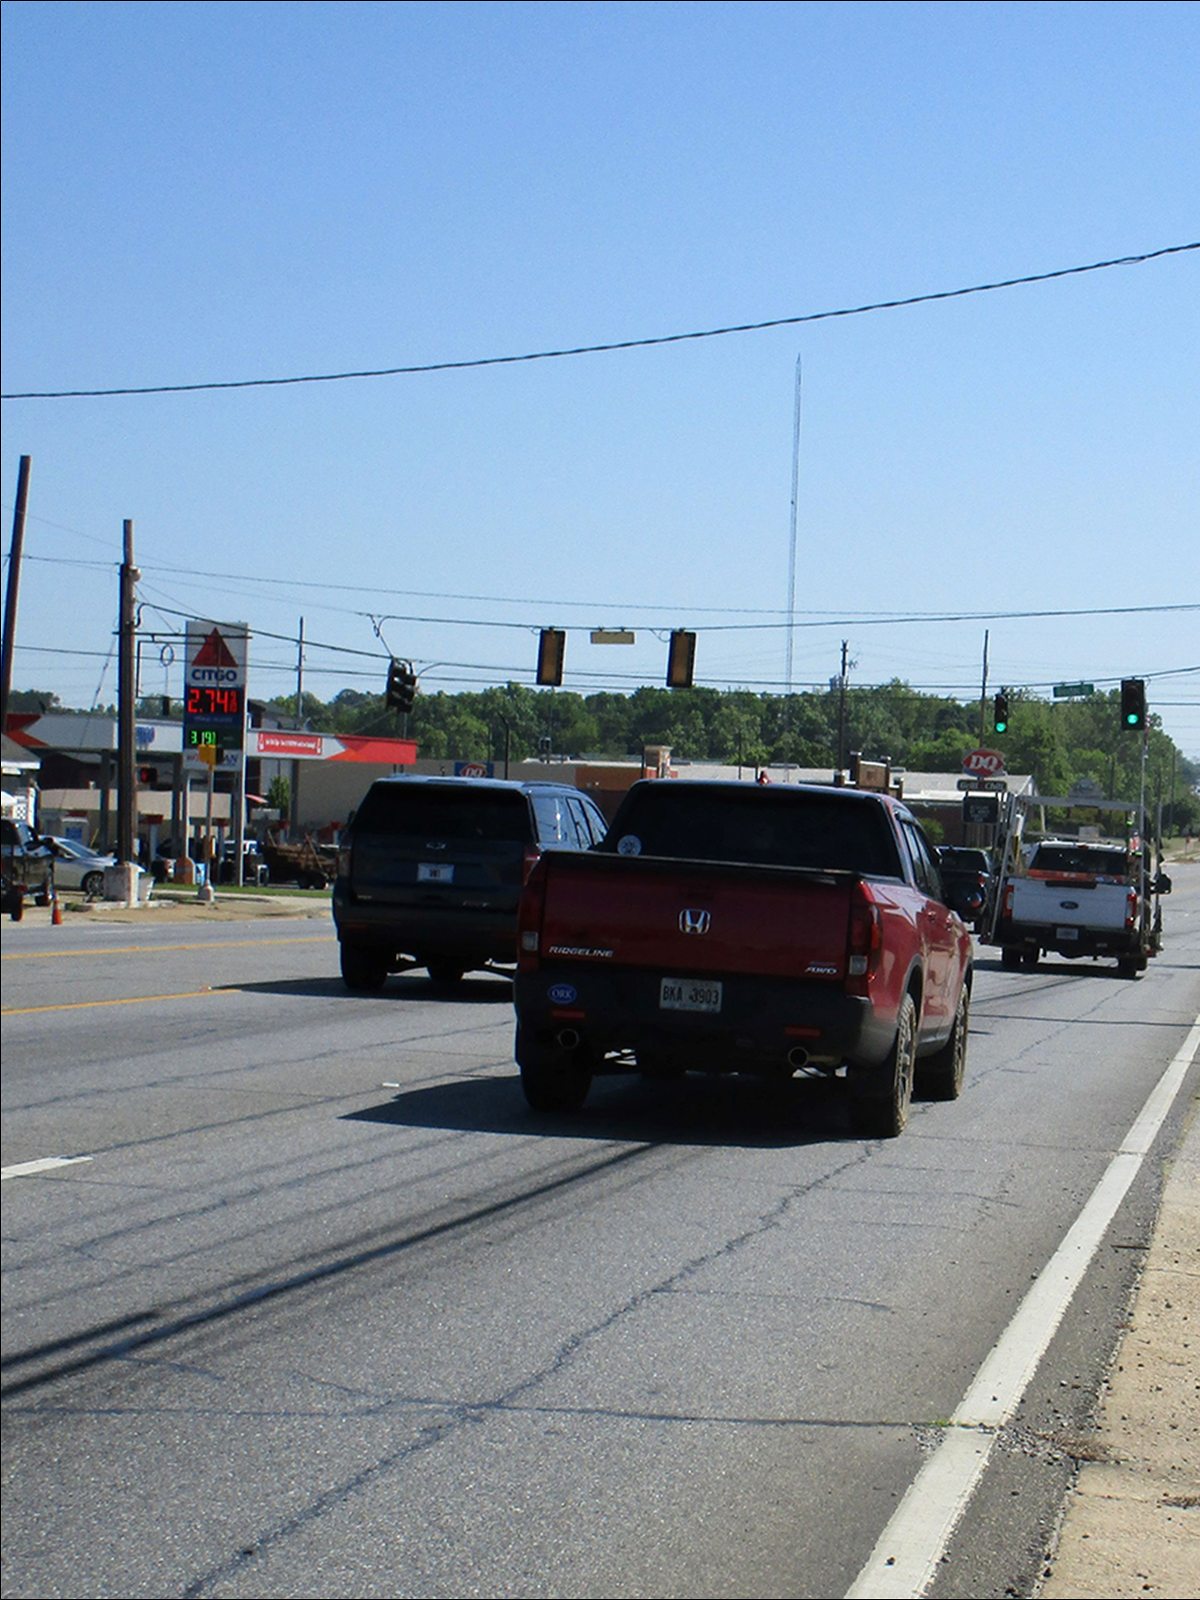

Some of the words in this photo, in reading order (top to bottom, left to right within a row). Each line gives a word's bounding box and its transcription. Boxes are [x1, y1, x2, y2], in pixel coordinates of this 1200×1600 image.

[191, 668, 237, 682] CITGO
[969, 755, 998, 772] DQ
[549, 946, 613, 957] RIDGELINE
[805, 966, 836, 974] AWD
[663, 985, 682, 1001] BKA
